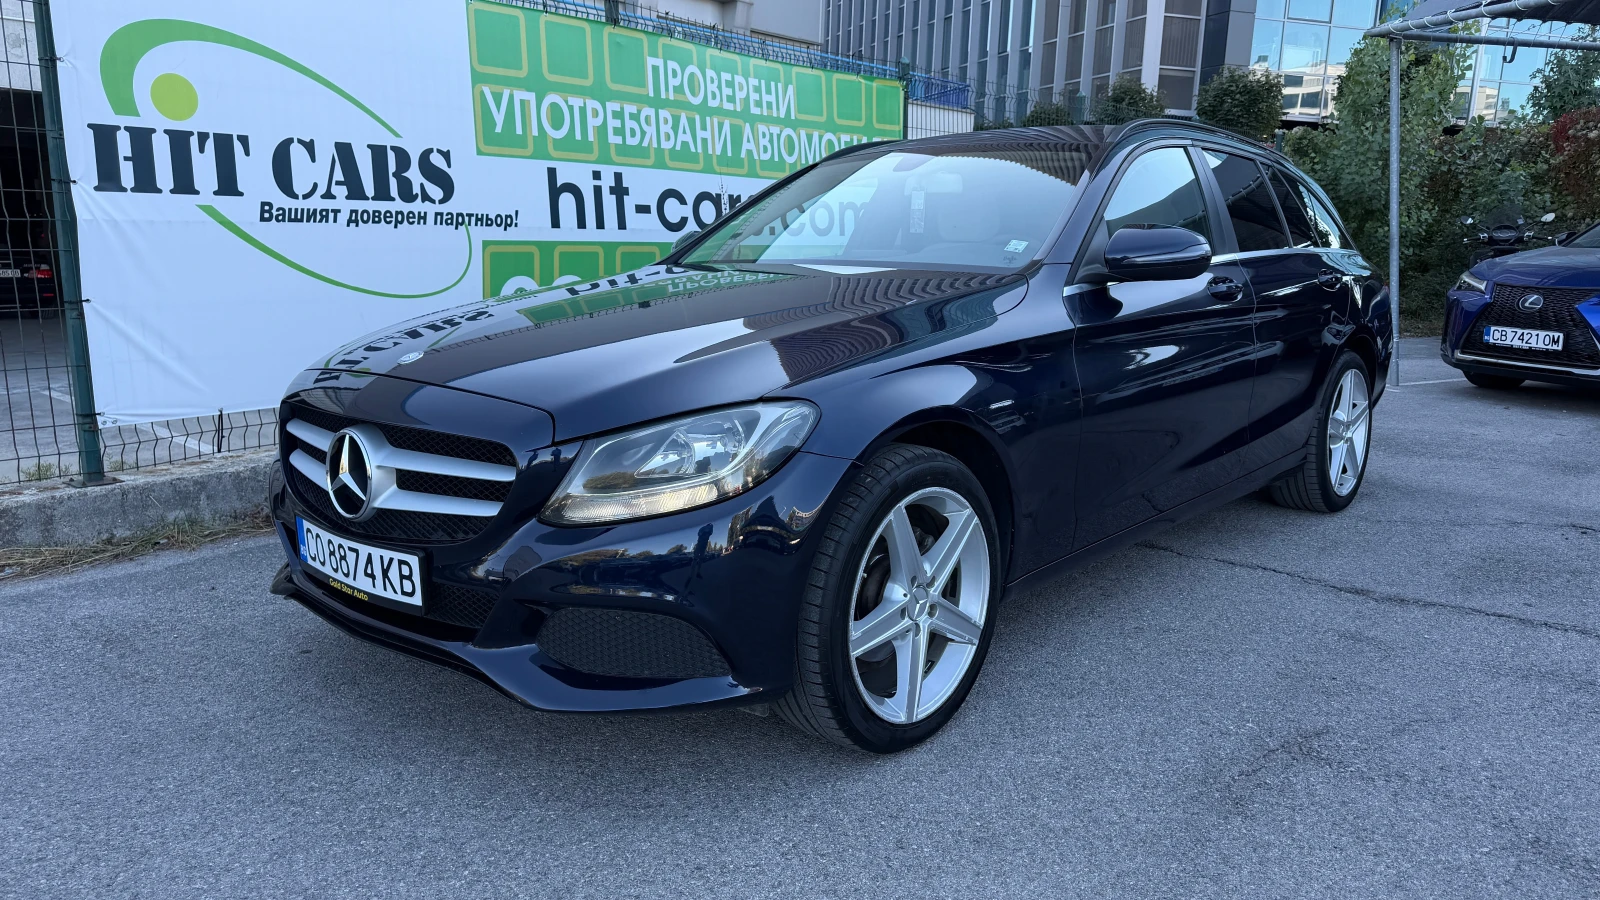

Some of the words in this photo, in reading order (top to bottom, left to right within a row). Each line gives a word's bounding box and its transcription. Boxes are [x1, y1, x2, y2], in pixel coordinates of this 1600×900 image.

[646, 56, 796, 120] ПРОВЕРЕНИ
[481, 86, 732, 158] УПОТРЕБЯВАНИ
[740, 122, 889, 164] АВТОМО
[87, 123, 251, 197] HIT
[272, 137, 456, 205] CARS
[259, 201, 341, 226] Вашият
[346, 206, 428, 229] доверен
[433, 209, 519, 232] партньор!
[329, 578, 341, 590] Gold
[341, 583, 353, 595] Star
[353, 589, 369, 601] Auto
